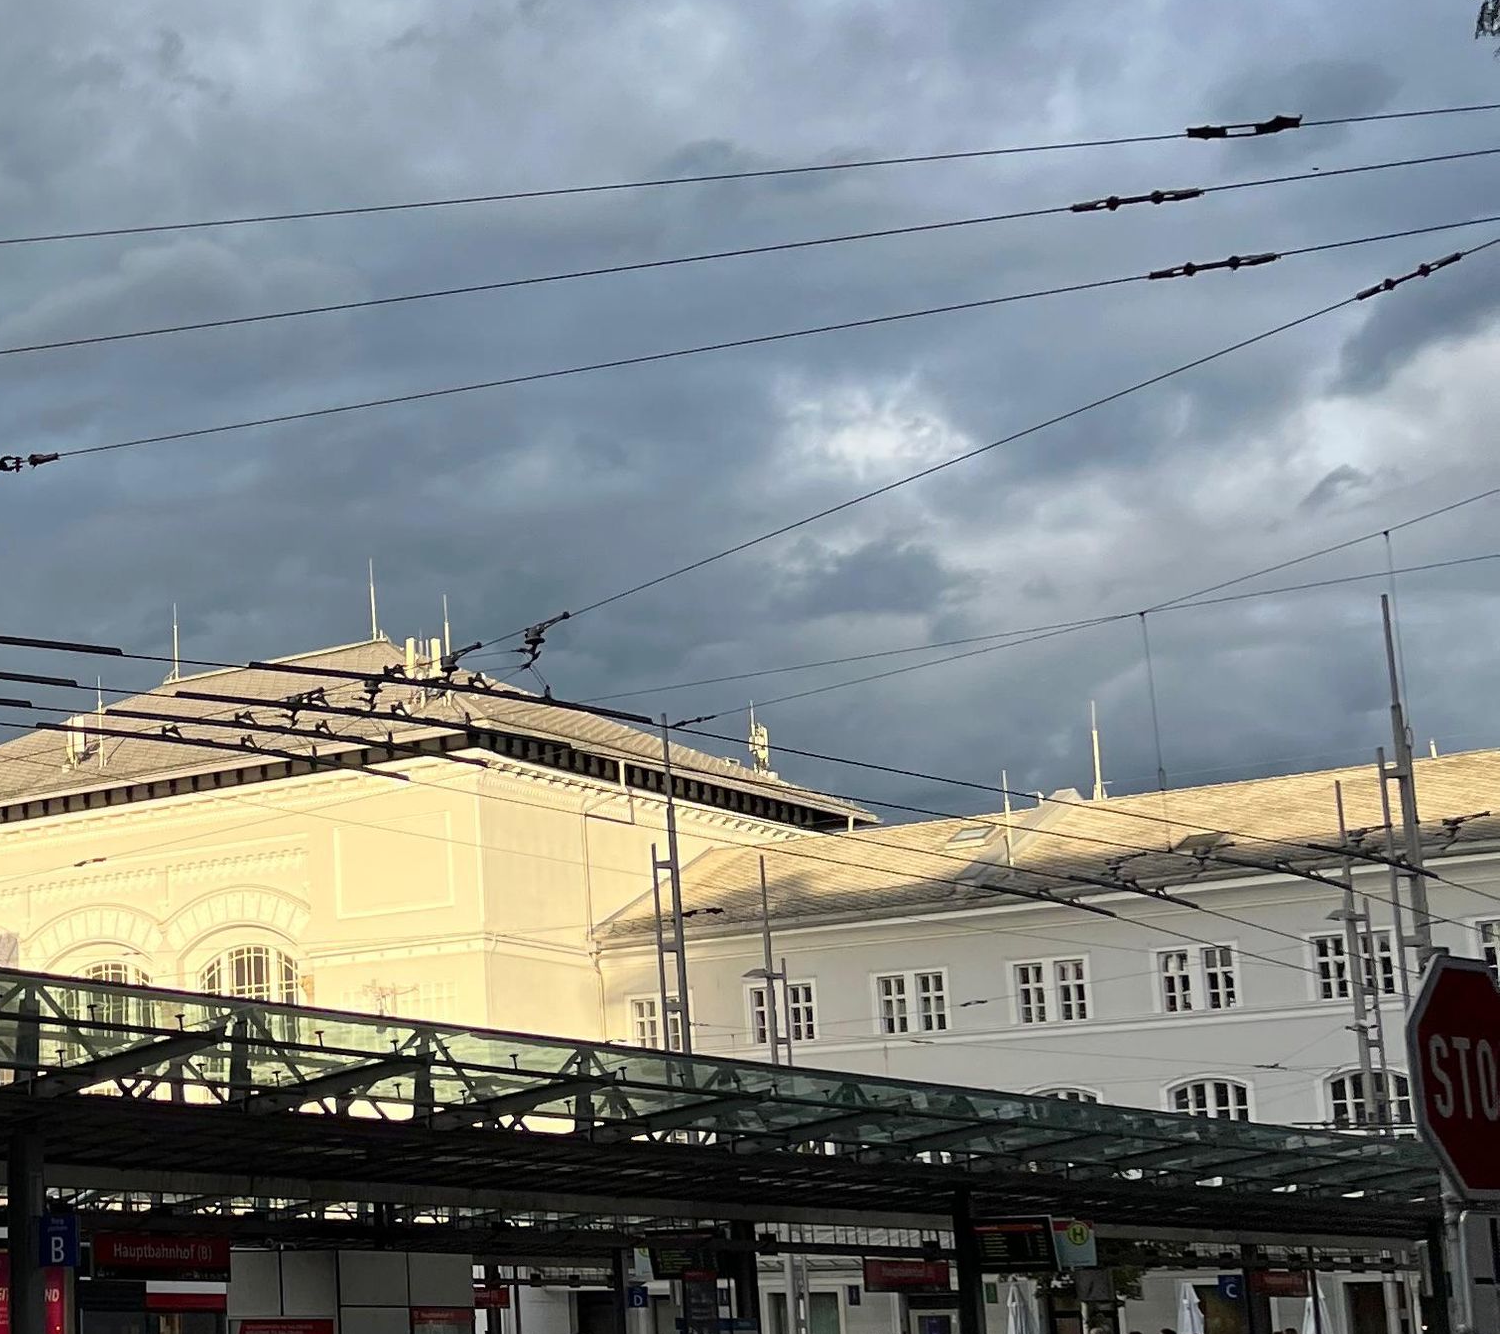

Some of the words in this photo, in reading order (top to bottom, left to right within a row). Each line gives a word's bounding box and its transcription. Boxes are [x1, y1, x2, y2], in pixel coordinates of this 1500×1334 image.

[51, 1236, 65, 1264] B
[113, 1243, 196, 1263] Hauptbahnhof
[633, 1294, 643, 1307] D
